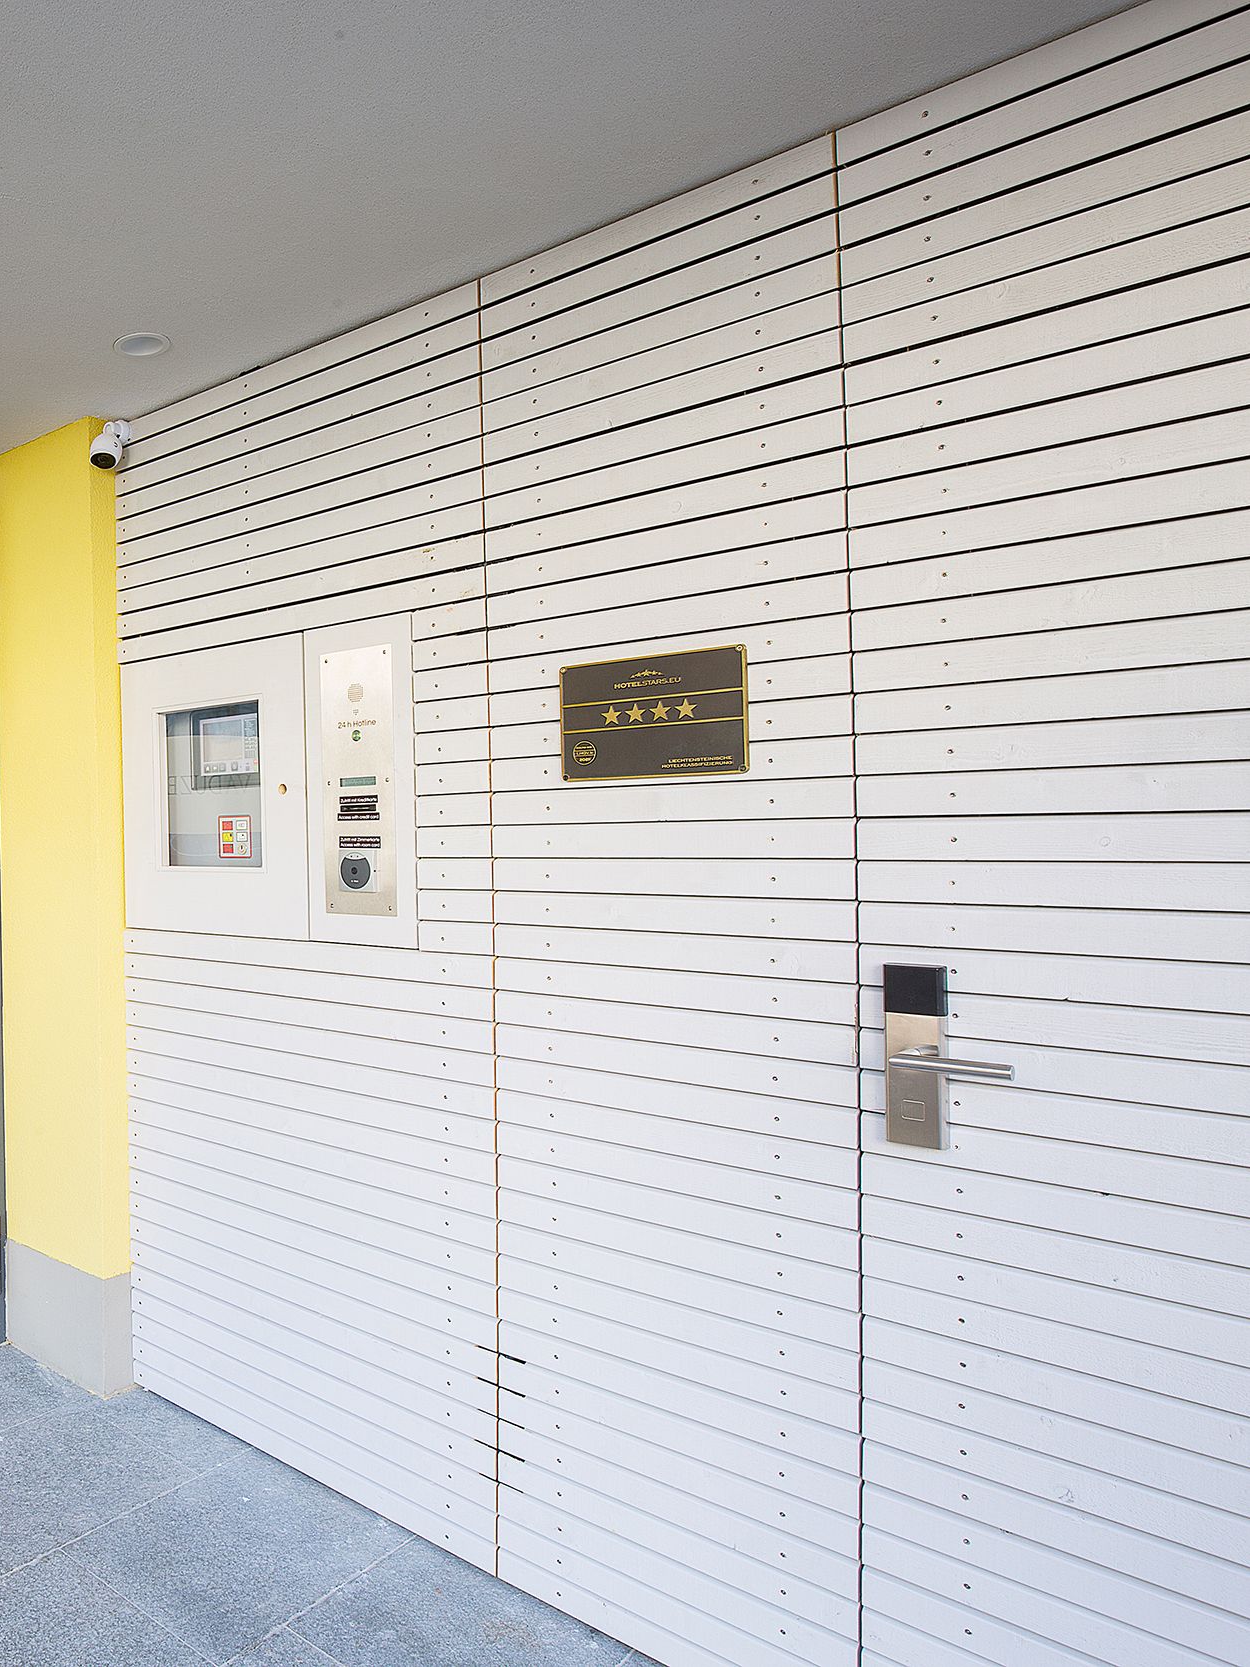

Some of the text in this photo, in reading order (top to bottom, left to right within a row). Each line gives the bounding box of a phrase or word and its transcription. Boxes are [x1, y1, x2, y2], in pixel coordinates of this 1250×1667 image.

[613, 677, 682, 690] HOTELSTARS.EU
[352, 719, 377, 727] Hotline
[668, 755, 733, 764] LIECHTENSTEINISCHE
[661, 761, 733, 769] HOTELKLASSIFIZIERUNG
